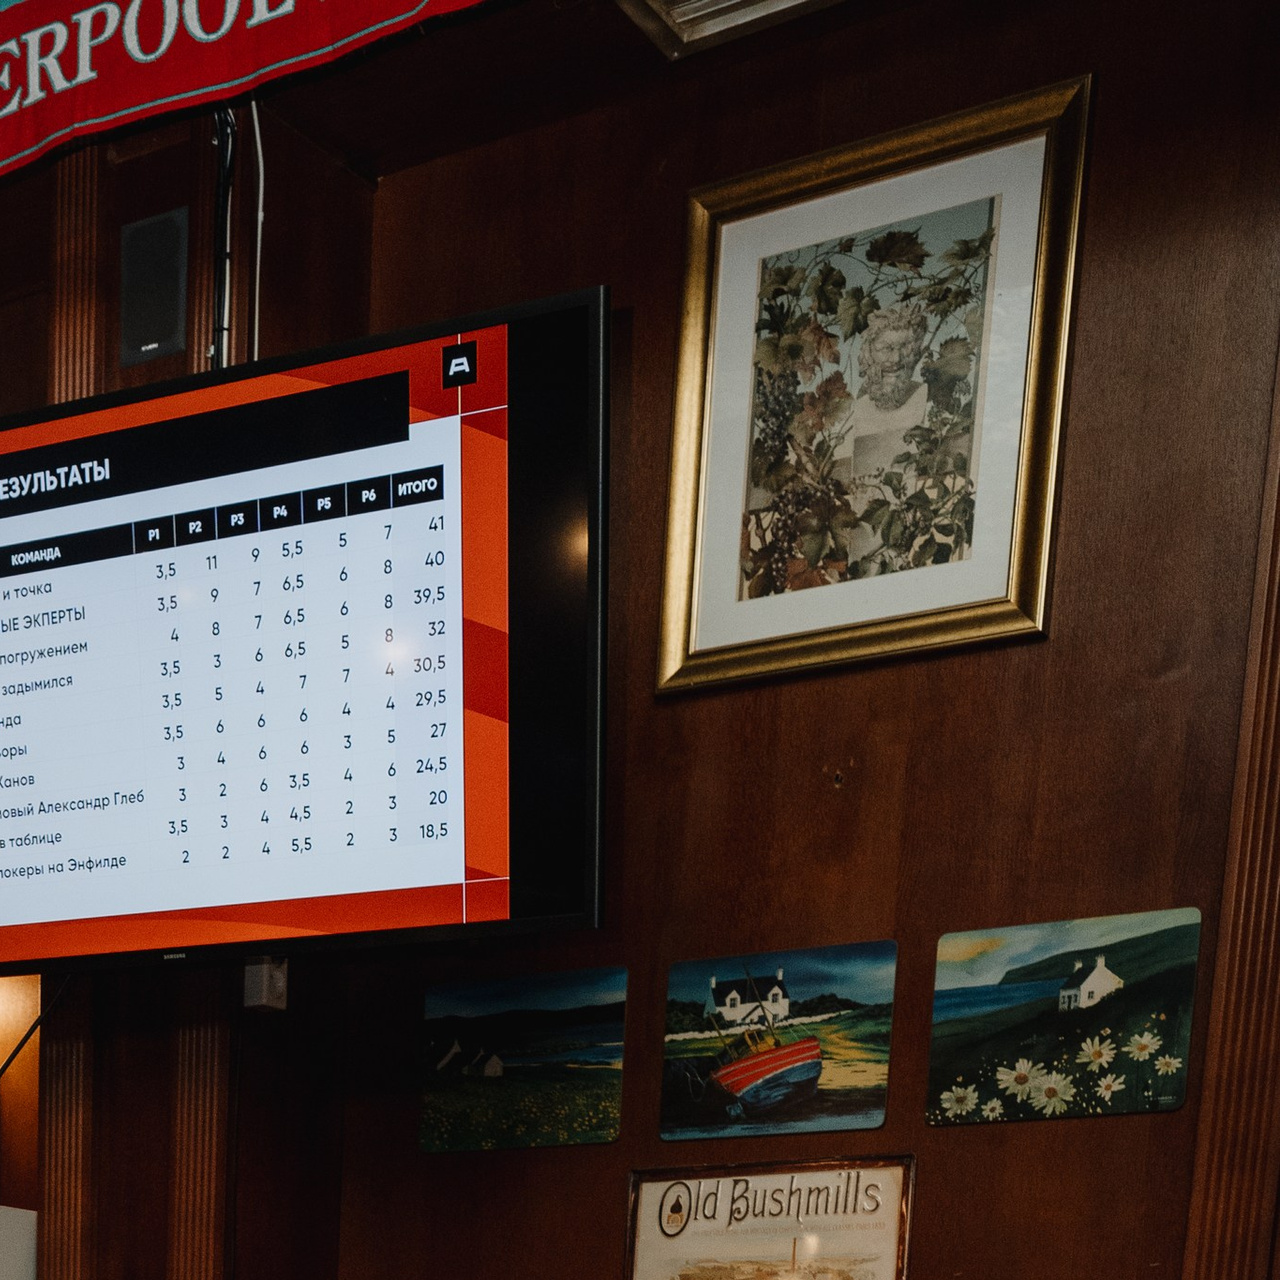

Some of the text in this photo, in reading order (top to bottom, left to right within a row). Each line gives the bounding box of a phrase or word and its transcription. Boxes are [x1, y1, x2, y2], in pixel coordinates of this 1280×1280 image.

[11, 546, 62, 566] КОМАНДА
[398, 477, 438, 497] ИТОГО
[2, 589, 11, 601] и
[13, 582, 53, 599] точка
[155, 561, 177, 581] 3,5
[205, 554, 218, 571] 11
[251, 547, 261, 563] 9
[281, 539, 304, 559] 5,5
[338, 532, 348, 548] 5
[383, 524, 392, 540] 7
[428, 514, 444, 532] 41
[22, 605, 86, 630] ЭКПЕРТЫ
[157, 594, 178, 613] 3,5
[210, 587, 219, 603] 9
[252, 580, 261, 596] 7
[282, 573, 305, 593] 6,5
[339, 566, 349, 582] 6
[383, 558, 393, 575] 8
[424, 550, 445, 568] 40
[170, 627, 180, 642] 4
[211, 621, 221, 637] 8
[254, 614, 263, 630] 7
[283, 607, 306, 627] 6,5
[339, 600, 349, 617] 6
[384, 593, 394, 610] 8
[413, 585, 446, 605] 39,5
[1, 675, 73, 697] задымился
[160, 659, 181, 678] 3,5
[213, 653, 222, 669] 3
[254, 647, 264, 663] 6
[284, 640, 307, 660] 6,5
[341, 634, 350, 650] 5
[384, 627, 394, 643] 8
[428, 619, 446, 637] 32
[161, 692, 183, 711] 3,5
[215, 686, 223, 702] 5
[255, 680, 265, 695] 4
[298, 674, 307, 690] 7
[342, 668, 351, 683] 7
[385, 663, 395, 676] 4
[413, 654, 446, 674] 30,5
[163, 724, 184, 743] 3,5
[215, 719, 225, 734] 6
[257, 713, 266, 729] 6
[299, 707, 309, 723] 6
[341, 701, 352, 716] 4
[385, 695, 396, 711] 4
[415, 688, 447, 708] 29,5
[177, 756, 185, 771] 3
[216, 750, 226, 765] 4
[258, 745, 268, 760] 6
[300, 740, 310, 755] 6
[343, 734, 352, 750] 3
[387, 728, 396, 744] 5
[430, 722, 447, 739] 27
[37, 796, 111, 815] Александр
[113, 788, 145, 806] Глеб
[178, 787, 187, 802] 3
[219, 782, 227, 798] 2
[259, 777, 269, 793] 6
[288, 772, 310, 791] 3,5
[343, 767, 353, 782] 4
[387, 762, 397, 777] 6
[415, 755, 448, 775] 24,5
[8, 832, 63, 848] таблице
[168, 819, 189, 836] 3,5
[220, 814, 229, 829] 3
[260, 809, 270, 824] 4
[289, 805, 312, 823] 4,5
[345, 800, 354, 815] 2
[388, 795, 397, 810] 3
[429, 789, 448, 806] 20
[47, 862, 64, 874] на
[67, 856, 127, 873] Энфилде
[181, 849, 190, 864] 2
[221, 845, 230, 860] 2
[261, 841, 271, 855] 4
[291, 836, 313, 854] 5,5
[346, 832, 355, 847] 2
[389, 827, 398, 842] 3
[419, 822, 448, 841] 18,5
[658, 1170, 883, 1237] Old Bushmills
